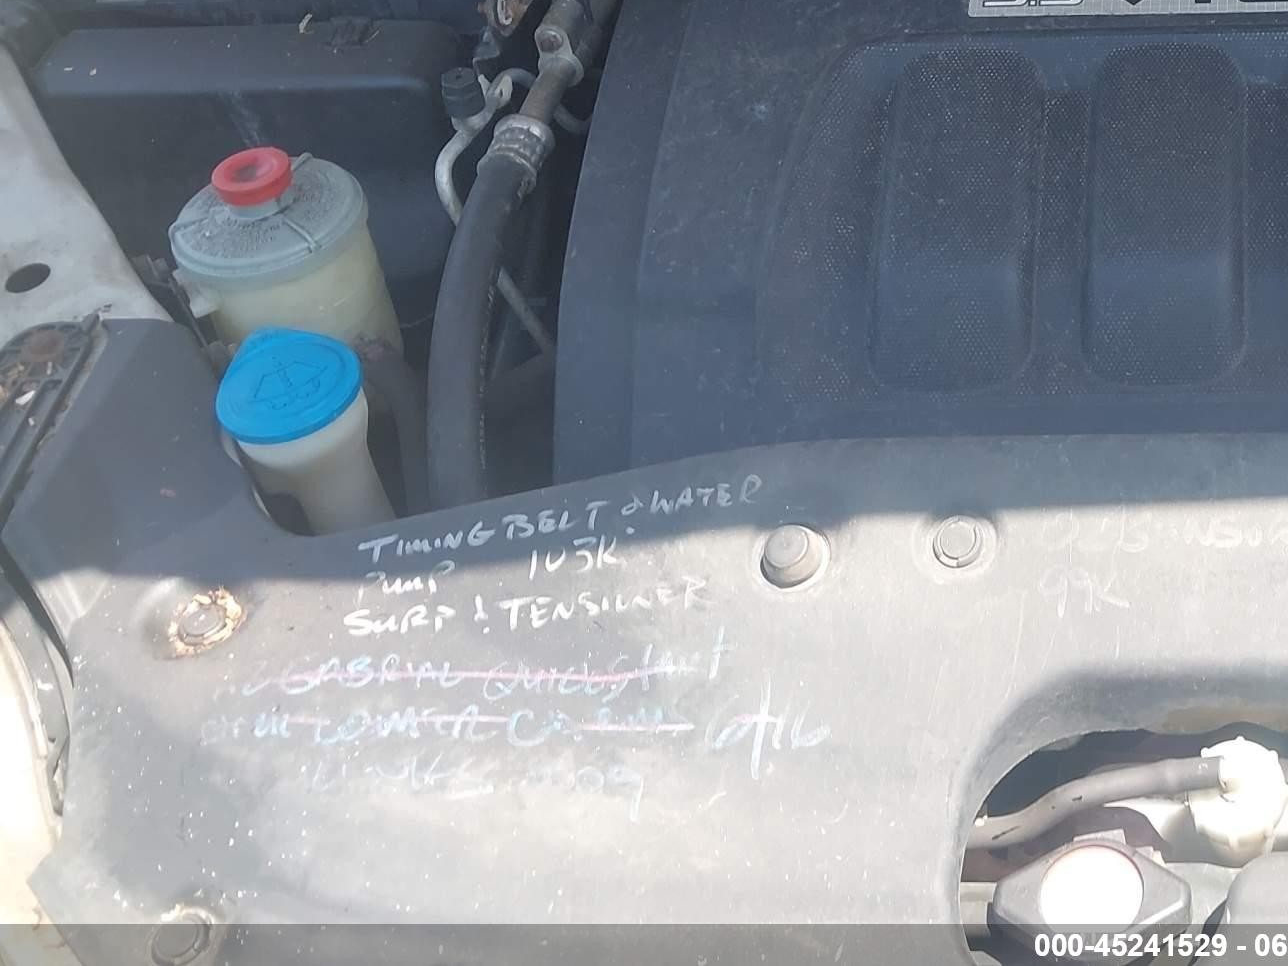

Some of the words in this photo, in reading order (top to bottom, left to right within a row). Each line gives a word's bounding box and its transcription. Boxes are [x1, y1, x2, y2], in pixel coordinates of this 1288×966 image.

[357, 521, 496, 565] TIMING
[501, 499, 611, 541] BELT
[649, 474, 762, 516] WATER
